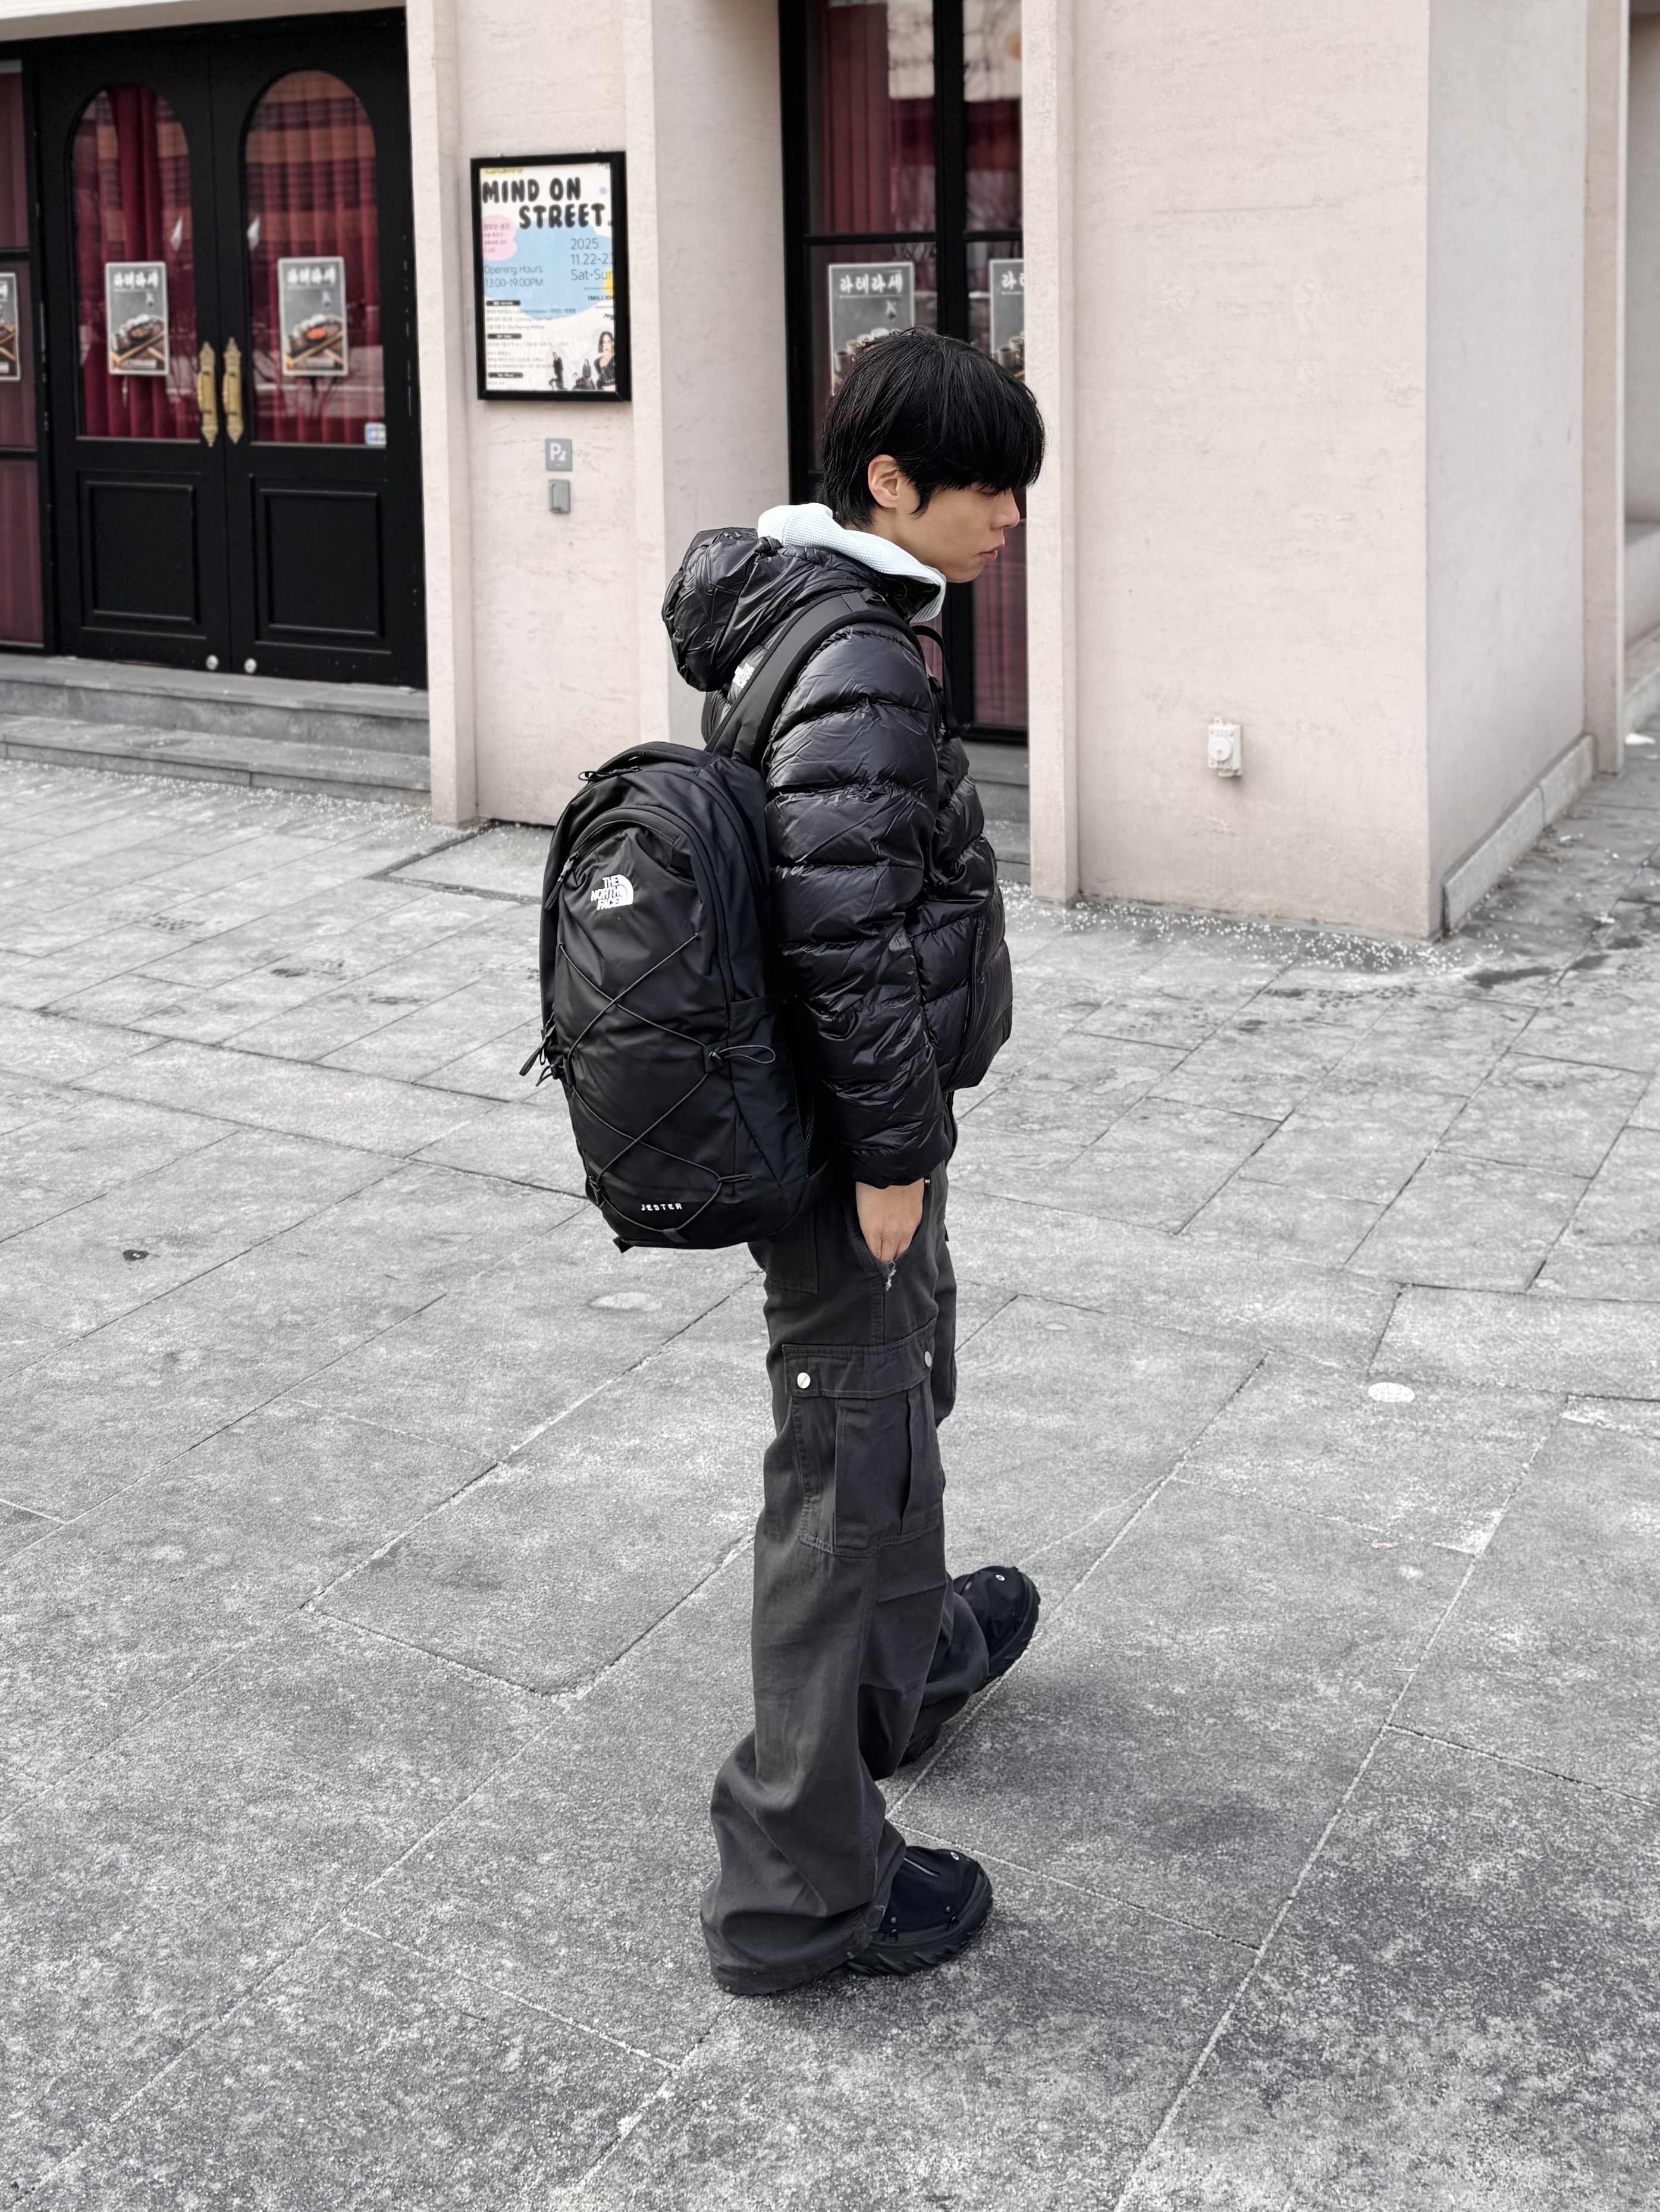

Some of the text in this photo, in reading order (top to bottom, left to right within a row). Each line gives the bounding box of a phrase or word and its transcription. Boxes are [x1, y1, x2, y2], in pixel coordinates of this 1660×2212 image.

[482, 177, 581, 204] MIND ON
[485, 265, 543, 276] Opening Hours
[602, 875, 619, 888] THE
[591, 886, 620, 902] NORTH
[597, 896, 620, 911] FACE
[641, 1203, 682, 1211] JESTER
